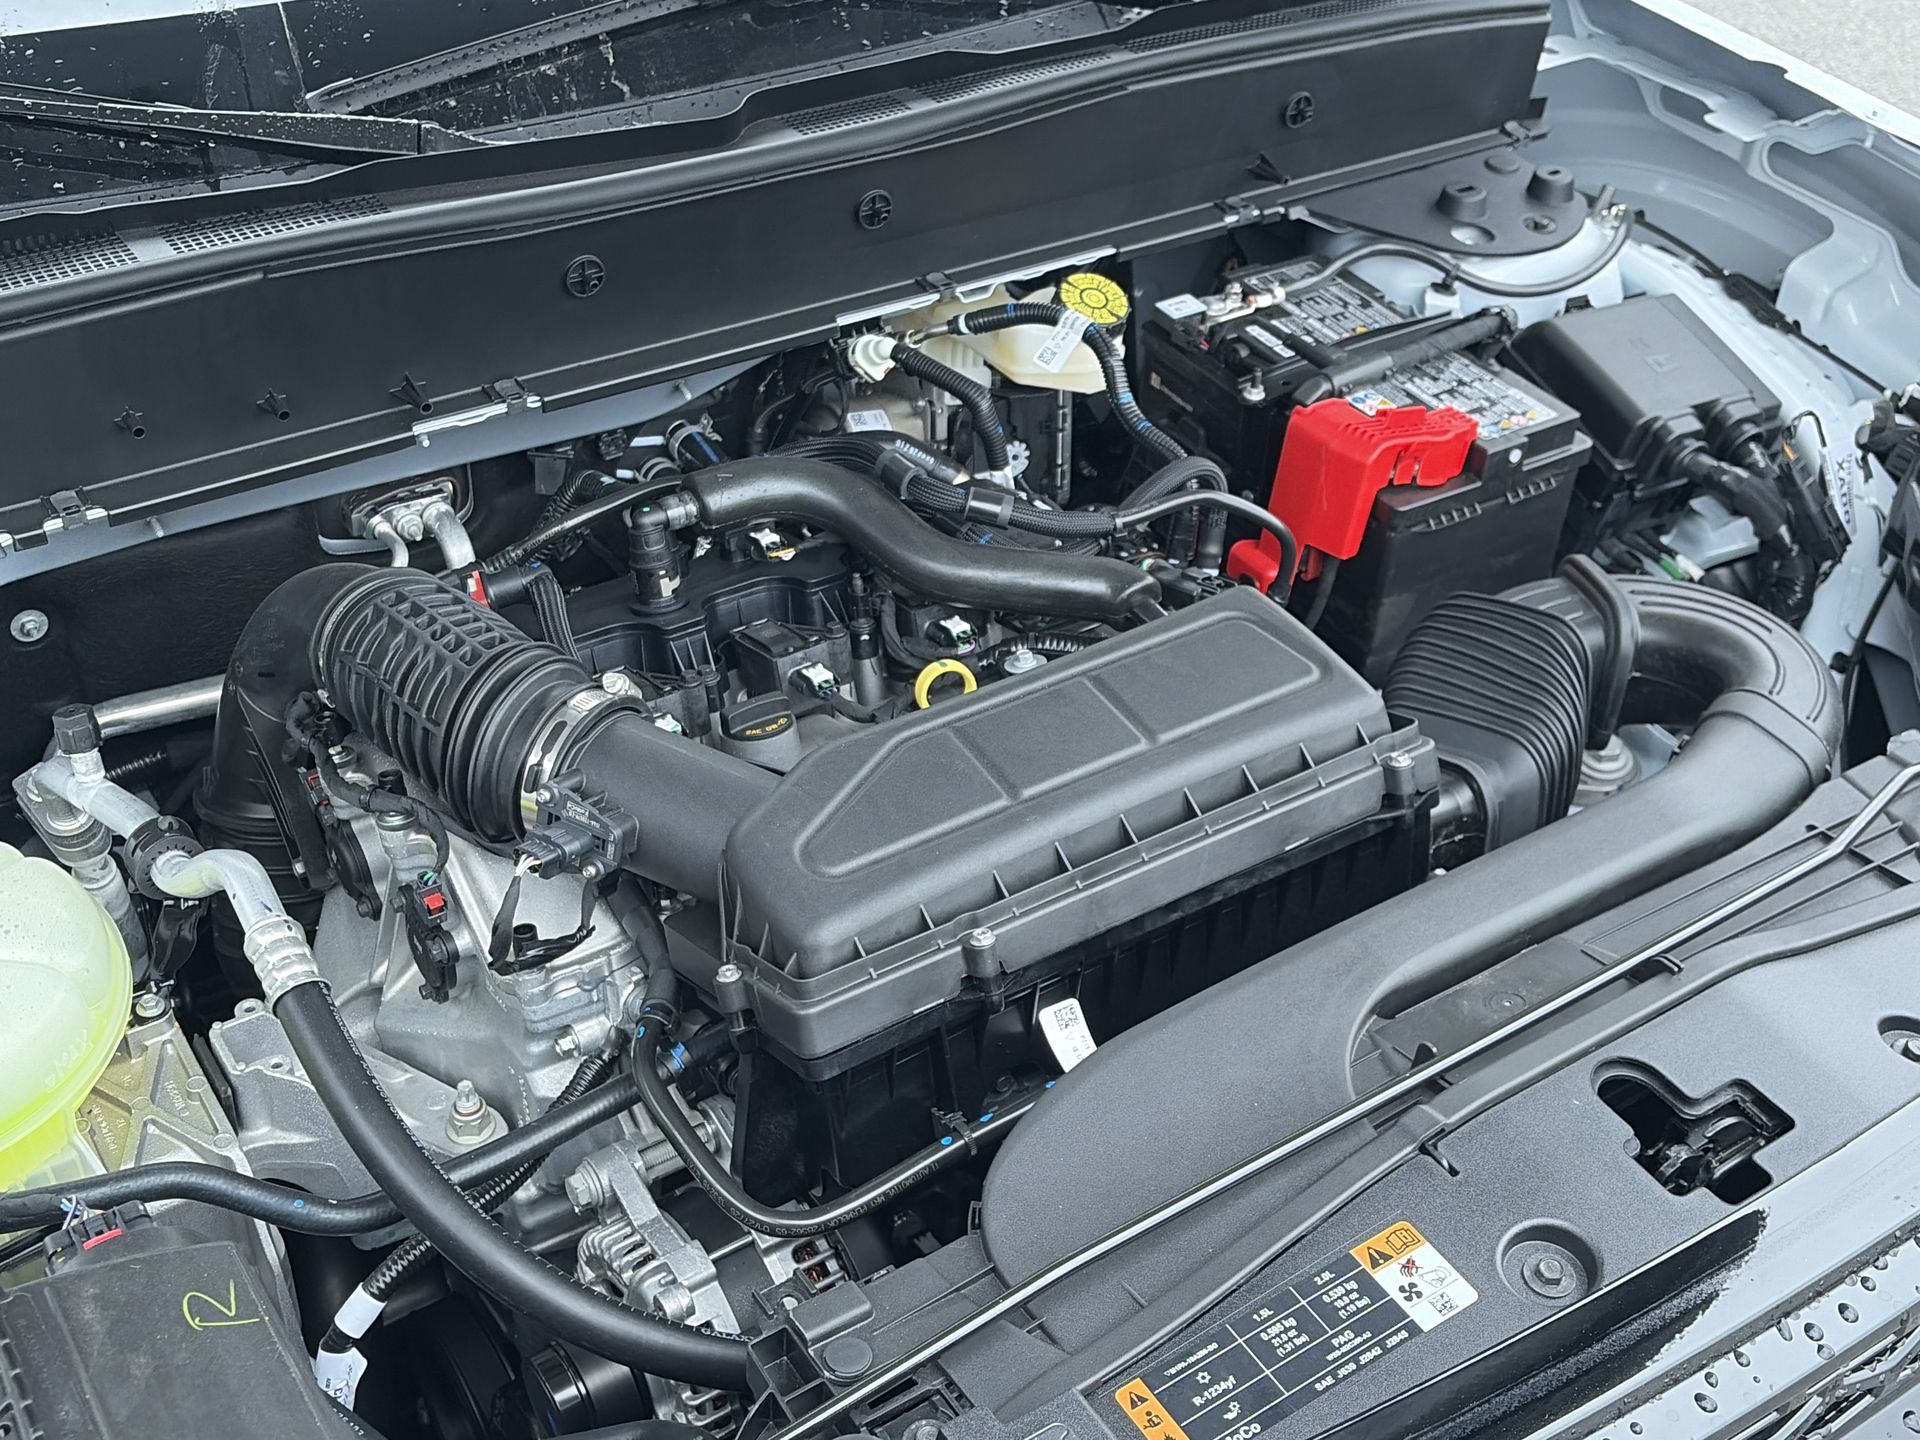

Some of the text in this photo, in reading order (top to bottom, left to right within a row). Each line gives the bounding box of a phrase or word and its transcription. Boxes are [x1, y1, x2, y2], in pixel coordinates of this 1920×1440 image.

[884, 1165, 931, 1198] AUTOMOTIVE
[1313, 1270, 1336, 1285] 2.0L
[1322, 1280, 1359, 1303] 0.539 kg
[1252, 1307, 1275, 1322] 1.5L
[1282, 1317, 1298, 1328] kg
[1331, 1329, 1355, 1348] PAG
[1314, 1375, 1336, 1391] SAE
[1336, 1362, 1357, 1378] J639
[1192, 1375, 1237, 1406] R-1234yf
